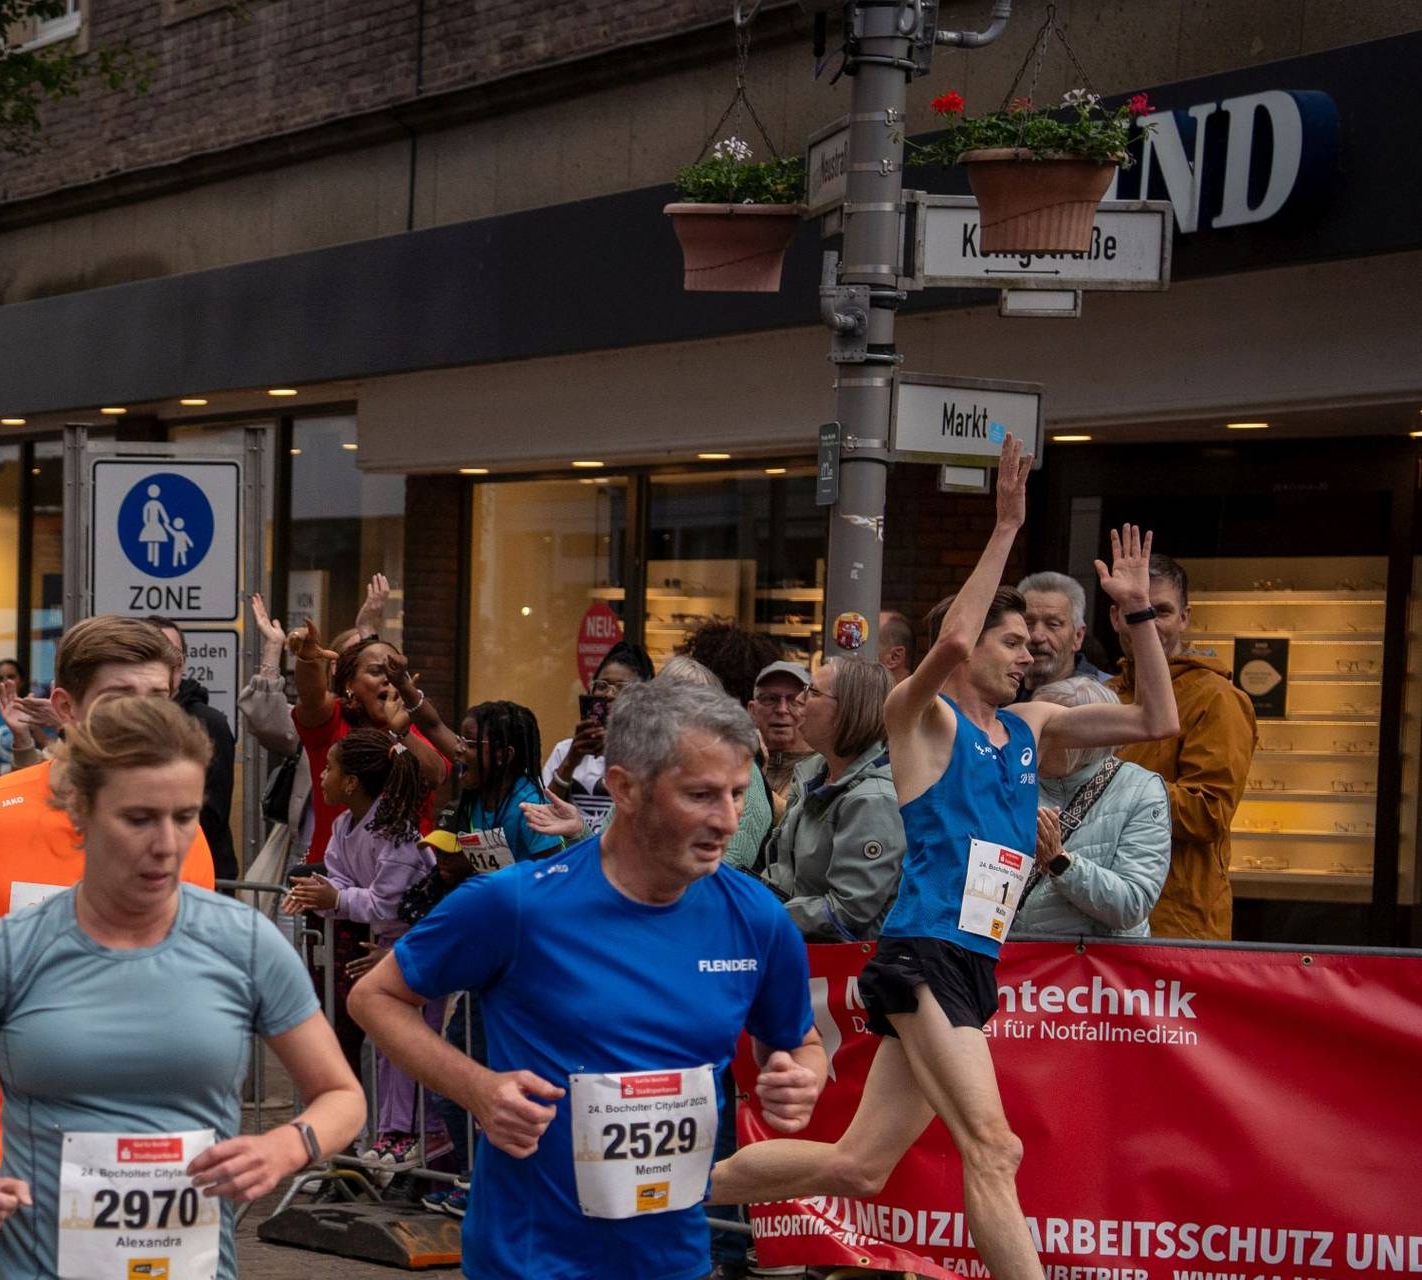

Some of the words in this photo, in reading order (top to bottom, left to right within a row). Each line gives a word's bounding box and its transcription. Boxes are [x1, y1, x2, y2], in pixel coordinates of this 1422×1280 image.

[1103, 90, 1304, 234] ND
[942, 402, 988, 438] Markt
[129, 586, 202, 610] ZONE
[586, 616, 616, 638] NEU:
[2, 797, 24, 808] JAKO
[1002, 881, 1010, 905] 1
[698, 959, 758, 972] FLENDER
[1004, 1018, 1034, 1038] für
[1040, 1020, 1198, 1046] Notfallmedizin
[588, 1105, 603, 1114] 24.
[605, 1103, 652, 1114] Bocholter
[655, 1100, 688, 1111] Citylauf
[689, 1096, 708, 1107] 2025
[602, 1117, 697, 1160] 2529
[99, 1169, 151, 1179] Bocholter
[635, 1163, 672, 1176] Memet
[93, 1187, 199, 1230] 2970
[116, 1236, 182, 1249] Alexandra
[1024, 1216, 1335, 1268] ARBEITSSCHUTZ
